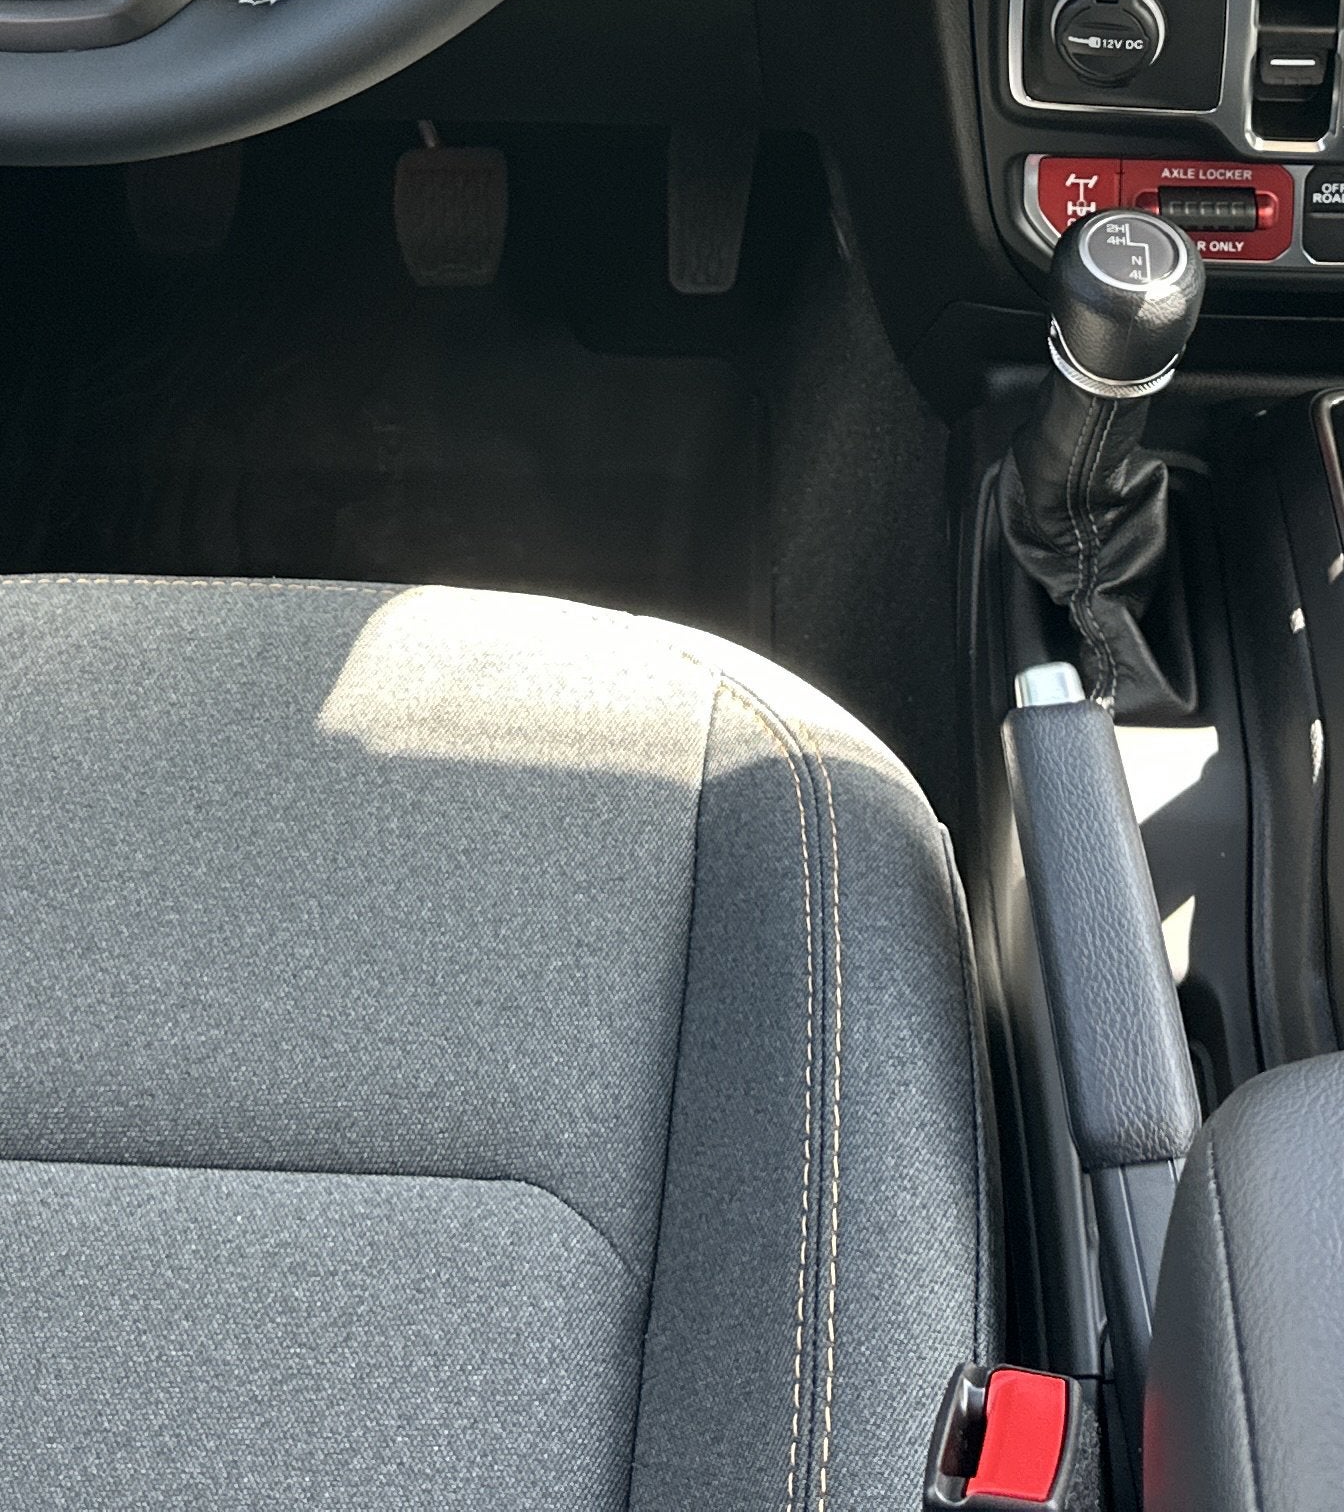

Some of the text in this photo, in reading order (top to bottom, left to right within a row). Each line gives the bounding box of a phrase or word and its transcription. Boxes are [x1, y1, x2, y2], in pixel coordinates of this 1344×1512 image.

[1102, 38, 1143, 50] 12V DC
[1161, 168, 1253, 181] AXLE LOCKER
[1209, 241, 1244, 253] ONLY
[1131, 255, 1142, 266] N
